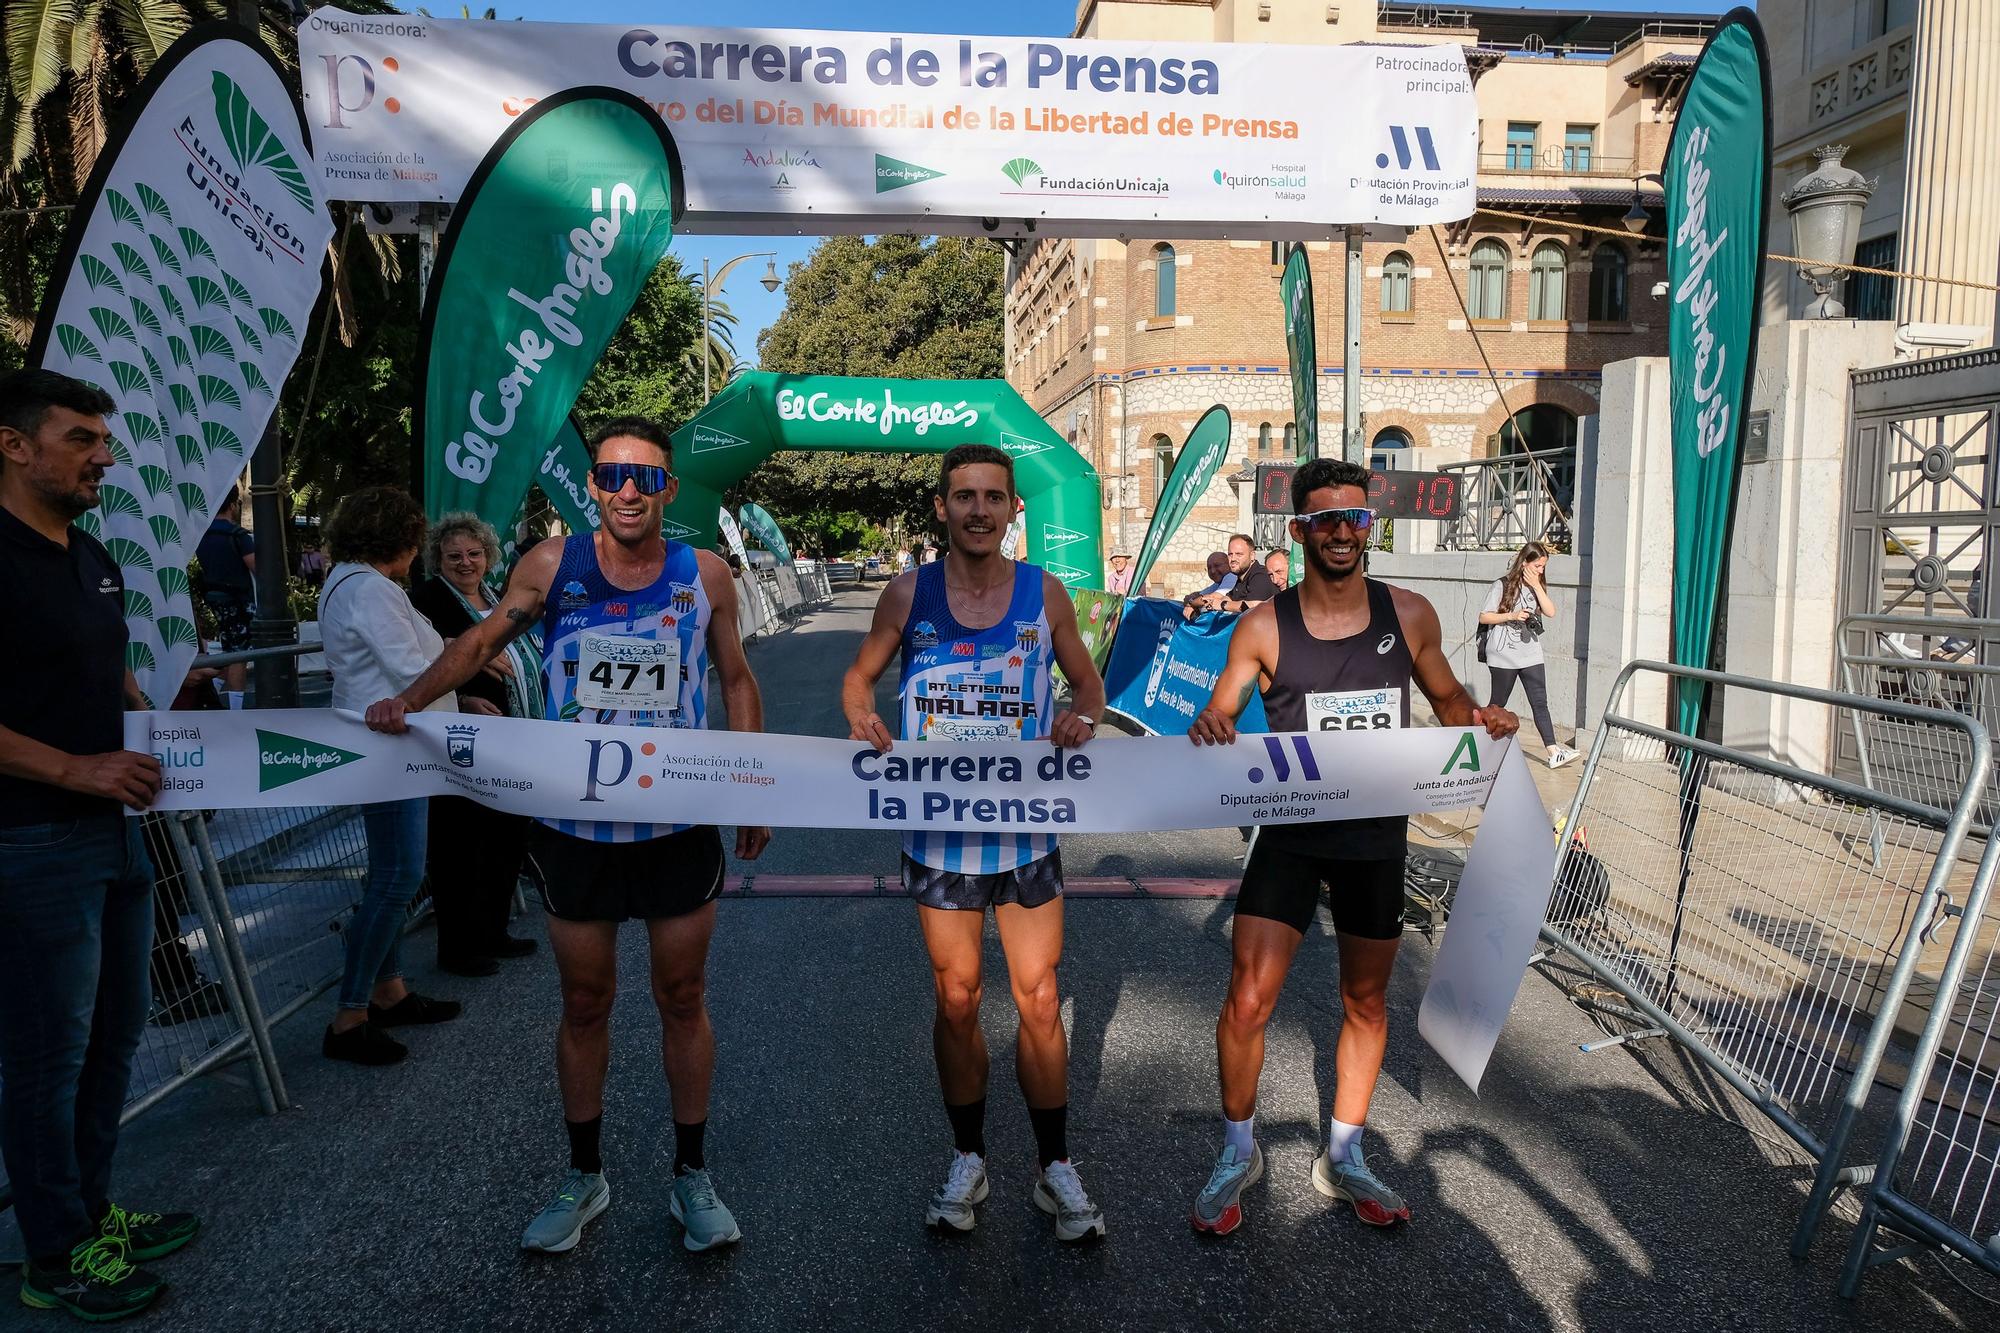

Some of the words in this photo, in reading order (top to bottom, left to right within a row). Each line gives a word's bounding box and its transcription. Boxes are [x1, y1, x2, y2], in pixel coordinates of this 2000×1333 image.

[310, 17, 427, 38] Organizadora:
[617, 29, 847, 84] Carrera
[866, 38, 940, 87] de
[959, 39, 1008, 88] la
[1027, 43, 1219, 95] Prensa
[1405, 79, 1469, 94] principal:
[695, 98, 744, 124] del
[753, 100, 804, 126] Día
[814, 102, 934, 129] Mundial
[943, 105, 981, 130] de
[990, 105, 1015, 131] la
[1024, 107, 1148, 135] Libertad
[1157, 111, 1194, 136] de
[1202, 113, 1299, 139] Prensa
[324, 151, 392, 164] Asociación
[395, 151, 411, 164] de
[413, 152, 425, 164] la
[742, 148, 822, 169] Andalucía
[325, 166, 371, 180] Prensa
[374, 168, 389, 180] de
[392, 168, 438, 183] Málaga
[1271, 164, 1306, 173] Hospital
[180, 116, 305, 254] Fundación
[1350, 177, 1410, 191] Dutación
[1412, 177, 1470, 191] Provincial
[1274, 190, 1306, 201] Málaga
[1379, 194, 1394, 205] de
[1395, 194, 1439, 207] Málaga
[186, 161, 275, 265] Unicaja
[507, 182, 637, 347] Inglés
[469, 329, 555, 437] Corte
[776, 389, 806, 421] El
[808, 390, 877, 425] Corte
[880, 388, 978, 436] Inglés
[445, 431, 499, 485] El
[588, 661, 666, 691] 471
[1166, 654, 1210, 689] Ayuntamiento
[928, 682, 1020, 695] ATLETISMO
[913, 695, 1038, 718] MÁLAGA
[1158, 682, 1170, 703] Área
[1169, 692, 1177, 709] de
[1176, 693, 1196, 717] Deporte
[148, 727, 201, 743] ospital
[261, 751, 275, 765] El
[274, 752, 301, 765] Corte
[301, 748, 342, 768] Inglés
[662, 753, 731, 768] Asociación
[734, 756, 749, 769] de
[752, 757, 764, 769] la
[851, 748, 1022, 783] Carrera
[1036, 747, 1092, 782] de
[160, 776, 204, 793] álaga
[405, 763, 473, 783] Ayuntamiento
[475, 776, 489, 786] de
[491, 777, 533, 791] Málaga
[661, 768, 707, 782] Prensa
[710, 770, 726, 783] de
[729, 770, 776, 787] Málaga
[1413, 781, 1441, 791] Junta
[1443, 779, 1455, 788] de
[869, 788, 907, 820] la
[923, 791, 1077, 824] Prensa
[1220, 791, 1287, 808] Diputación
[1290, 789, 1350, 803] Provincial
[1252, 807, 1268, 819] de
[1271, 805, 1316, 820] Málaga
